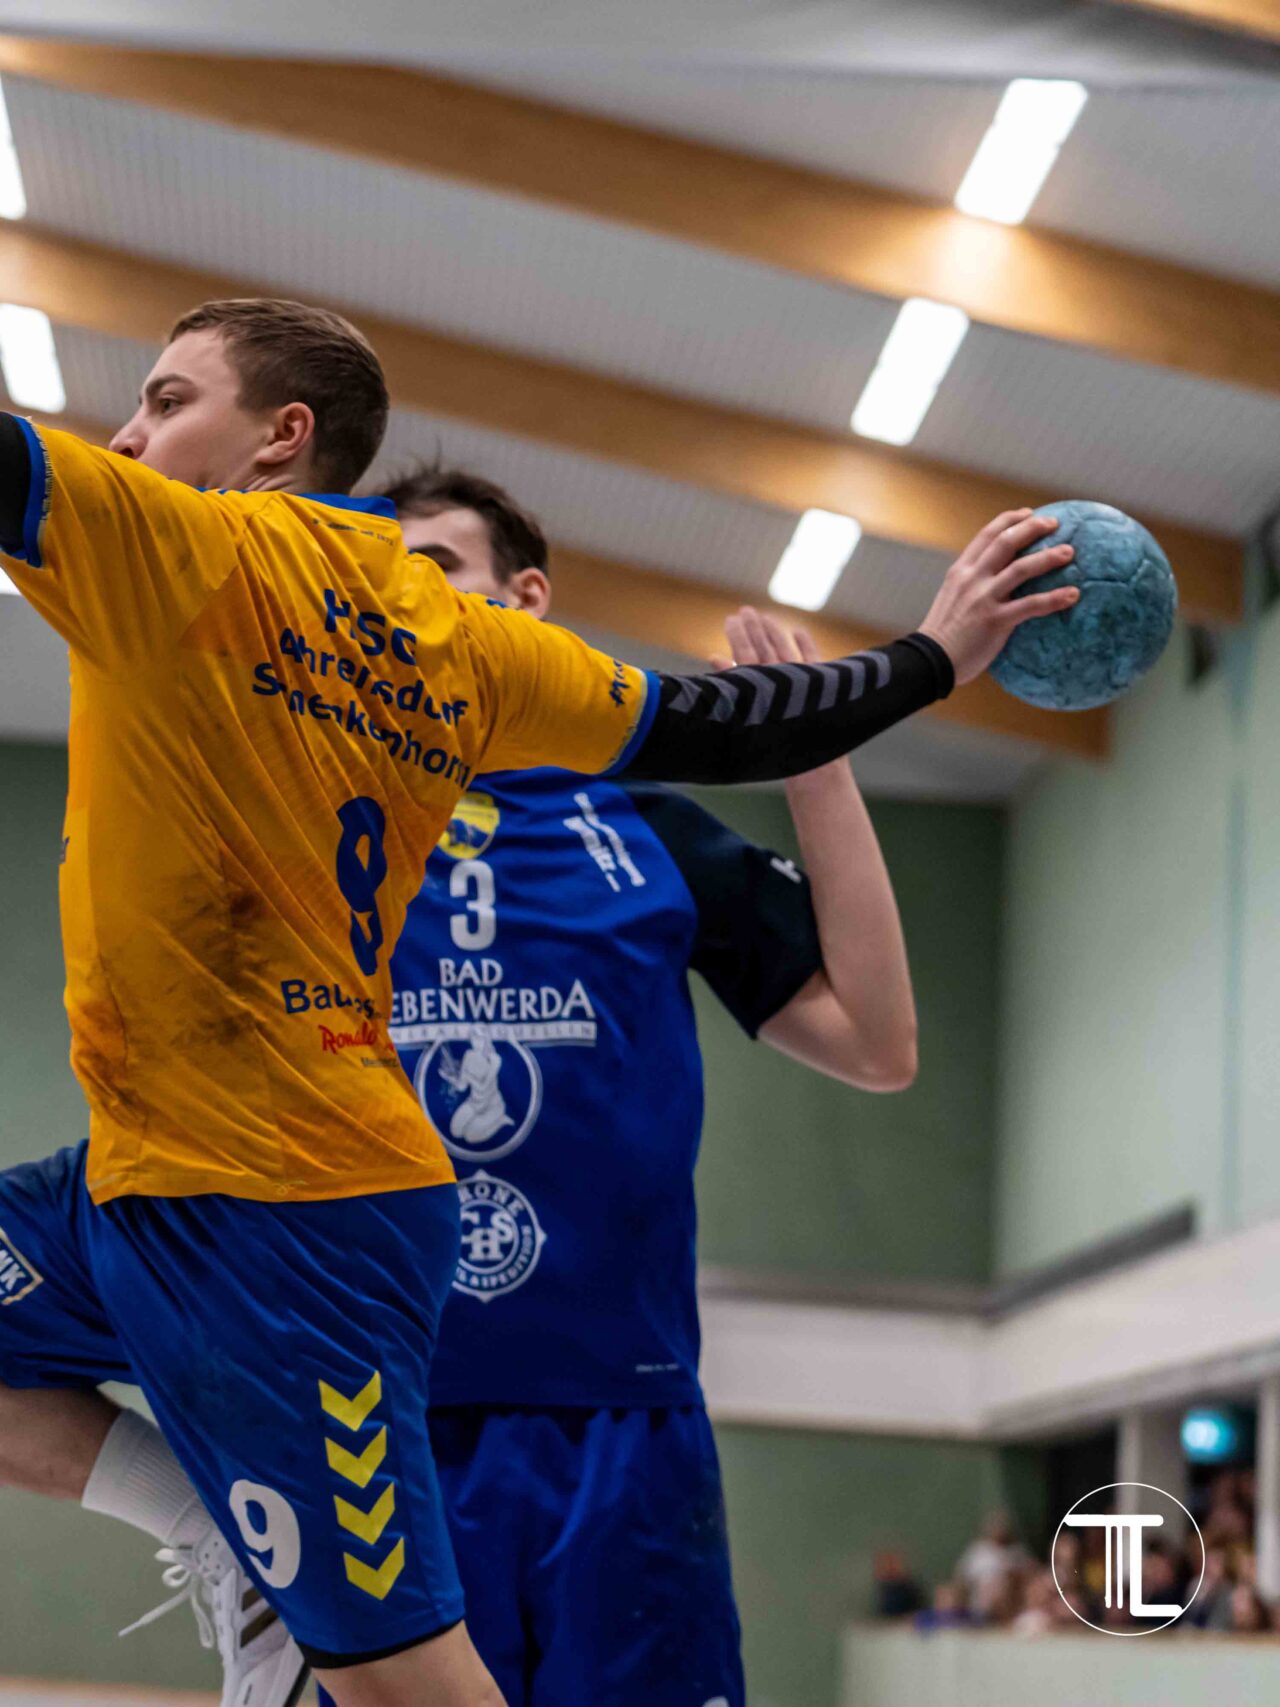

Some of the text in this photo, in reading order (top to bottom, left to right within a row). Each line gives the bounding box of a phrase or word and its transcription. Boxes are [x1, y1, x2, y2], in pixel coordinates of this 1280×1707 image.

[449, 860, 497, 951] 3
[439, 957, 504, 988] BAD
[388, 979, 597, 1026] EBENWERDA
[457, 1182, 525, 1218] RONE
[229, 1479, 301, 1589] 9
